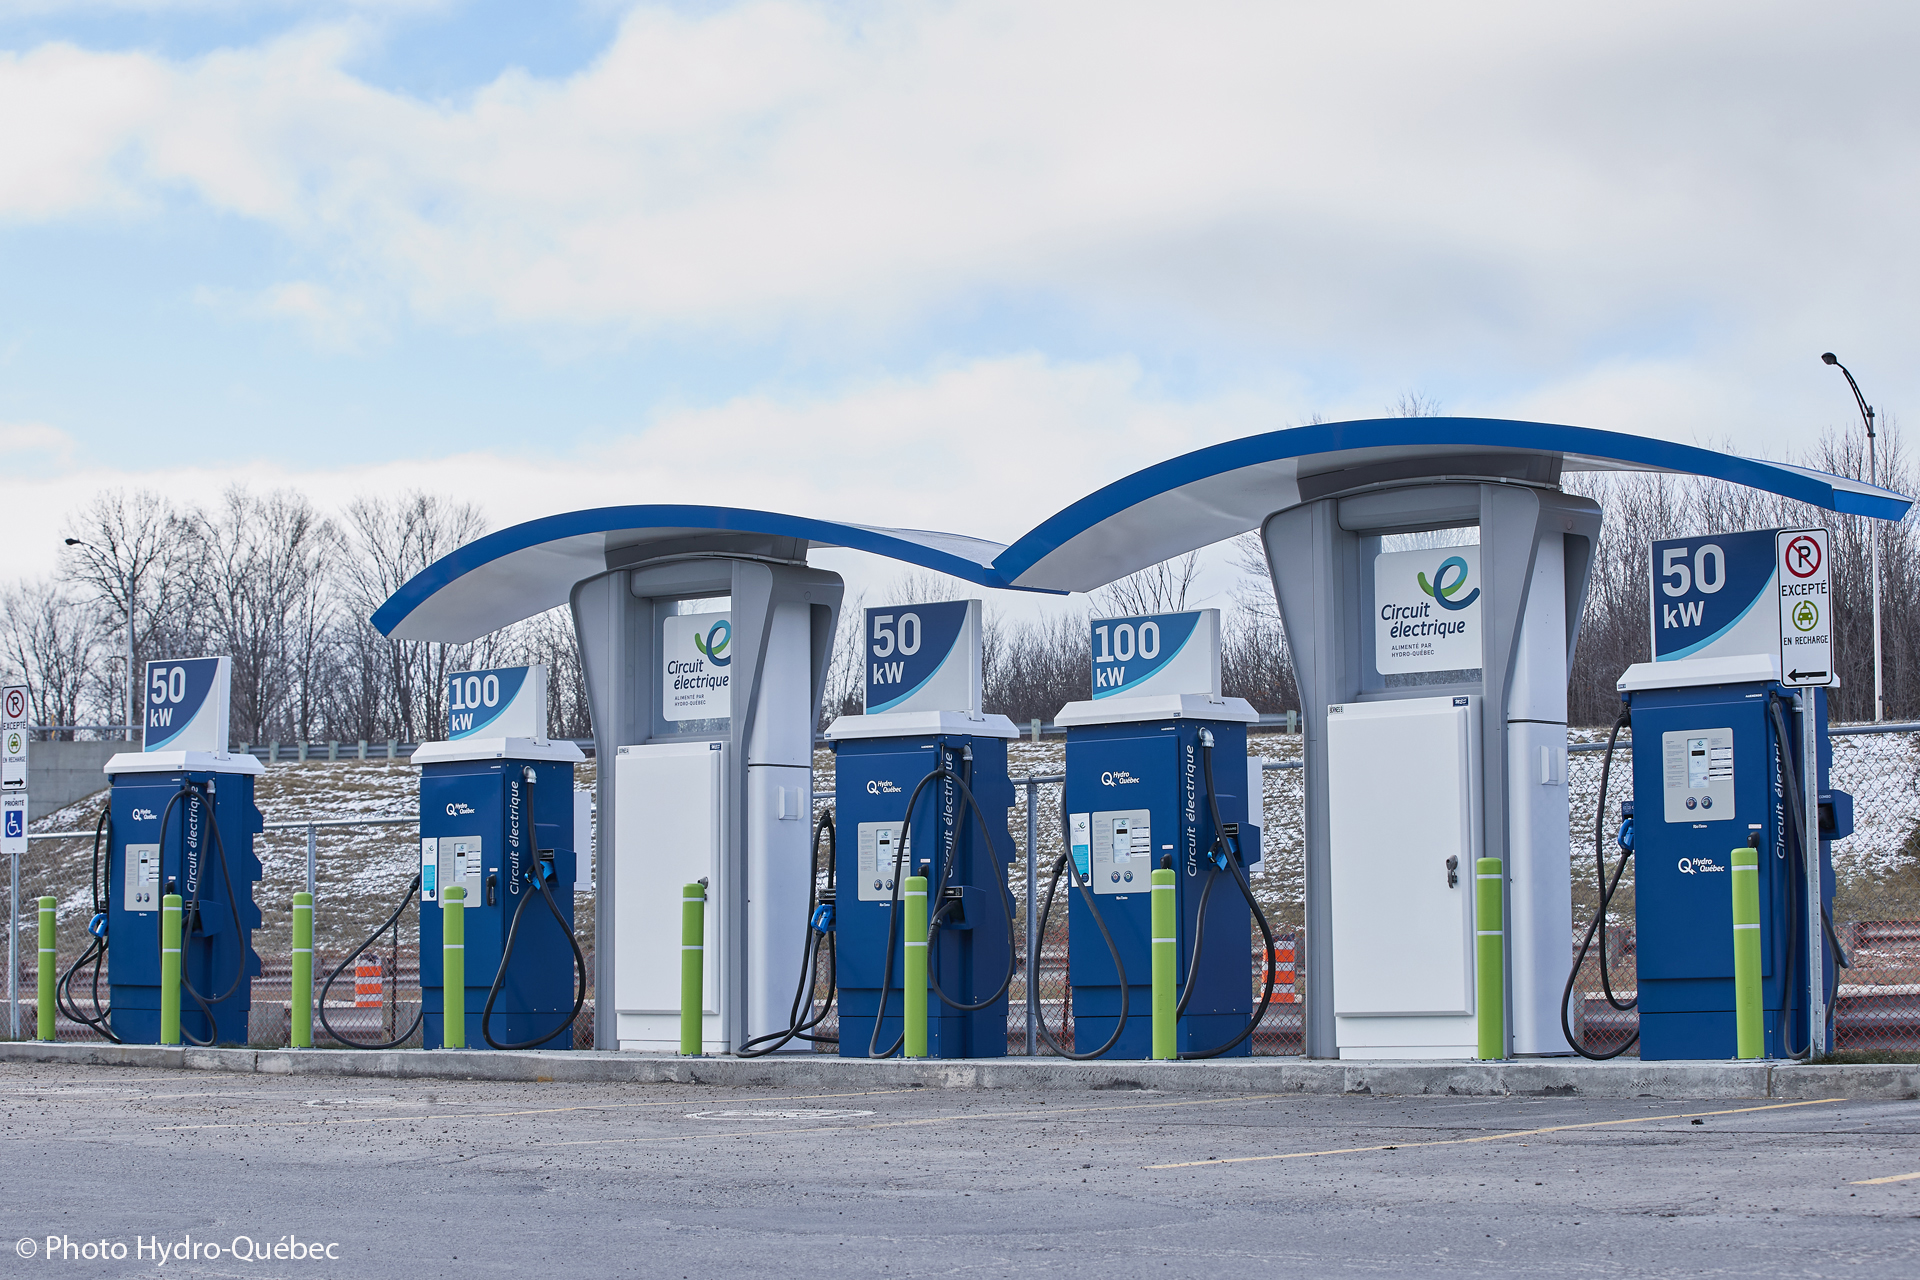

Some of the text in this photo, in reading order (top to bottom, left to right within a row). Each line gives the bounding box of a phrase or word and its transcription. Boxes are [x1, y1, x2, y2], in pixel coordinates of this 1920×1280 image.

[1662, 544, 1726, 597] 50
[1782, 580, 1827, 596] EXCEPTÉ
[1381, 602, 1430, 620] Circuit
[1663, 600, 1704, 629] kW
[872, 612, 922, 658] 50
[1390, 619, 1466, 638] électrique
[1096, 621, 1160, 663] 100
[1784, 634, 1828, 646] EN RECHARGE
[668, 659, 704, 674] Circuit
[873, 662, 904, 685] kW
[151, 666, 186, 704] 50
[674, 674, 730, 690] électrique
[1096, 666, 1125, 688] kW
[452, 674, 500, 710] 100
[3, 720, 26, 730] EXCEPTÉ
[150, 708, 173, 727] kW
[452, 713, 474, 731] kW
[1113, 771, 1130, 779] Hydro
[1118, 776, 1140, 785] Québec
[1186, 744, 1197, 876] Circuit électrique
[509, 781, 521, 895] Circuit électrique
[1776, 803, 1785, 859] Circuit
[187, 851, 198, 892] Circuit
[1692, 858, 1712, 866] Hydro
[1700, 864, 1724, 873] Québec
